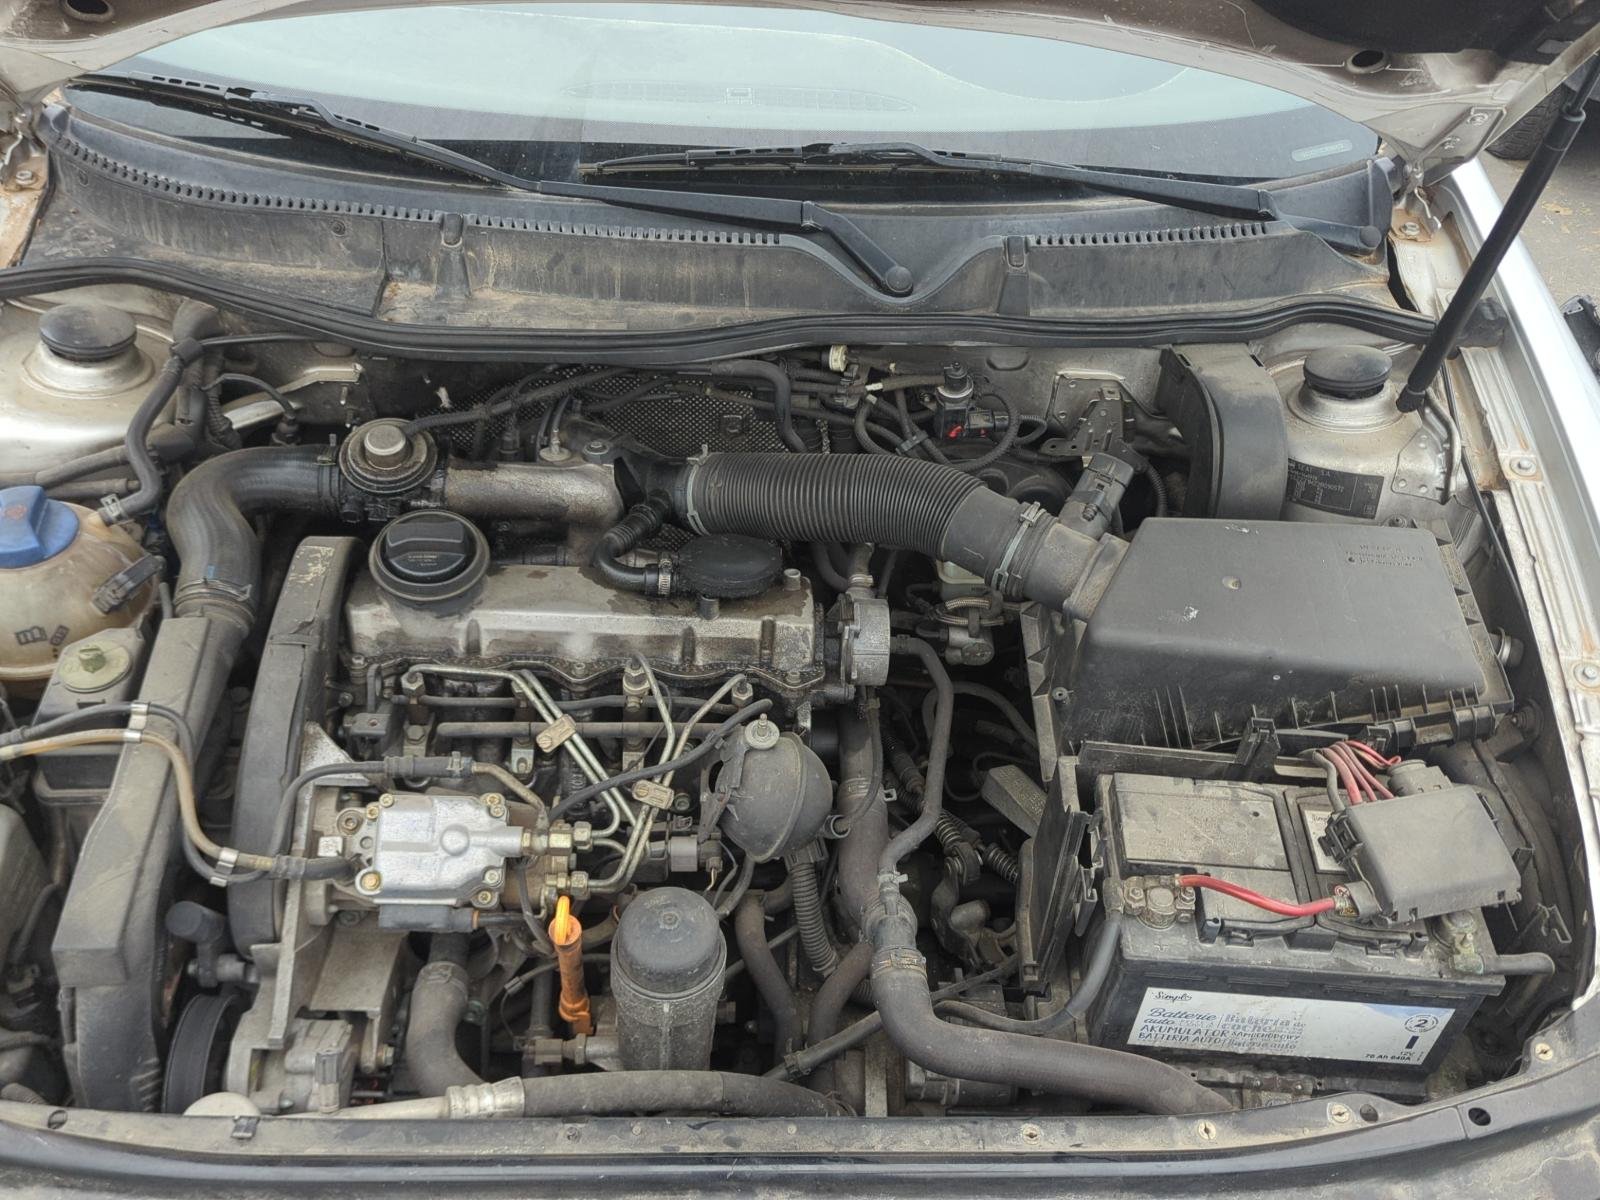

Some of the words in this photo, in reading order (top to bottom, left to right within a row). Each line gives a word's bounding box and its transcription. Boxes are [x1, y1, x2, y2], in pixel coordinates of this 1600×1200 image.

[1148, 1007, 1217, 1021] Batterie
[1414, 1019, 1428, 1028] 2
[1140, 1024, 1230, 1038] AKUMULATOR
[1138, 1032, 1189, 1042] BATTERIA
[1191, 1036, 1221, 1044] AUTO
